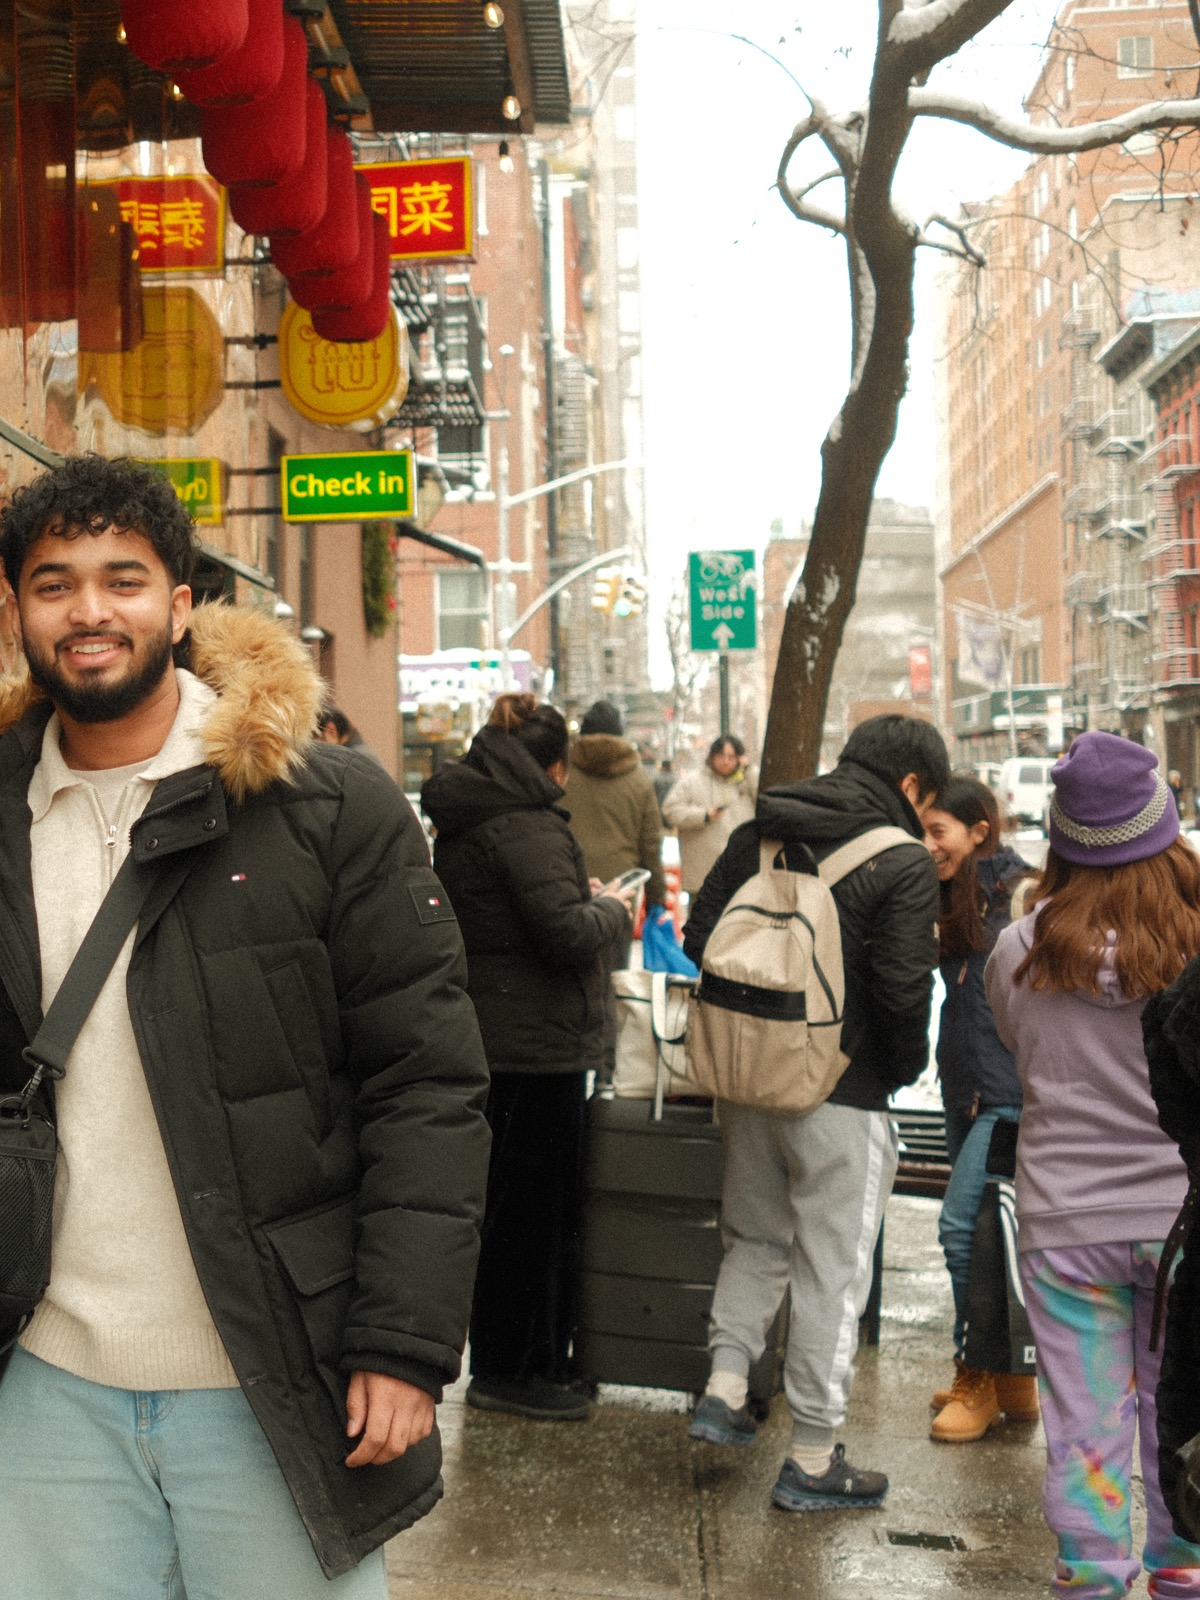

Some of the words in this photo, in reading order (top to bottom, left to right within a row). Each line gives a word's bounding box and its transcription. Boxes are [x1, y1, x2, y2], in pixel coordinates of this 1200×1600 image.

[290, 471, 372, 498] Check
[379, 470, 404, 494] in
[701, 604, 745, 620] Side
